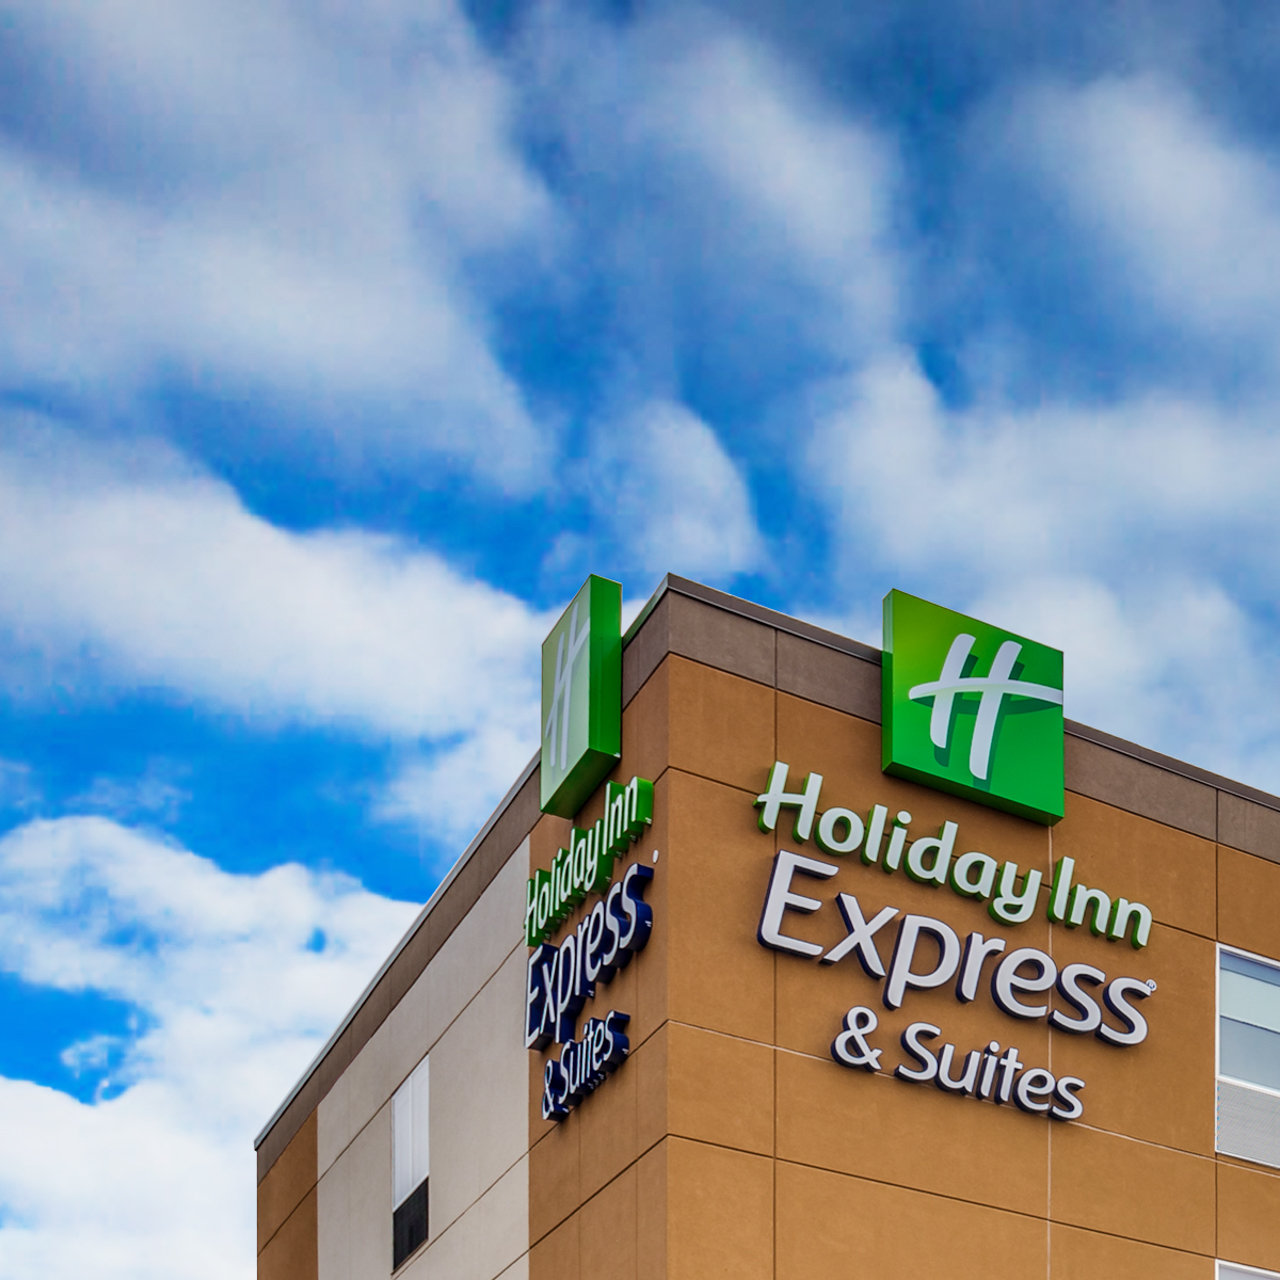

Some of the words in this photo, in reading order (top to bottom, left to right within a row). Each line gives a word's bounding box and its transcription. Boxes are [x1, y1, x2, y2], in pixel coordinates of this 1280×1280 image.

[524, 818, 606, 947] Holiday
[602, 775, 648, 860] Inn
[754, 761, 1042, 926] Holiday
[1047, 855, 1153, 949] Inn
[525, 862, 646, 1048] Express
[757, 849, 1154, 1048] Express
[541, 1059, 560, 1121] &
[558, 1010, 621, 1104] Suites
[830, 1005, 882, 1073] &
[895, 1022, 1085, 1121] Suites
